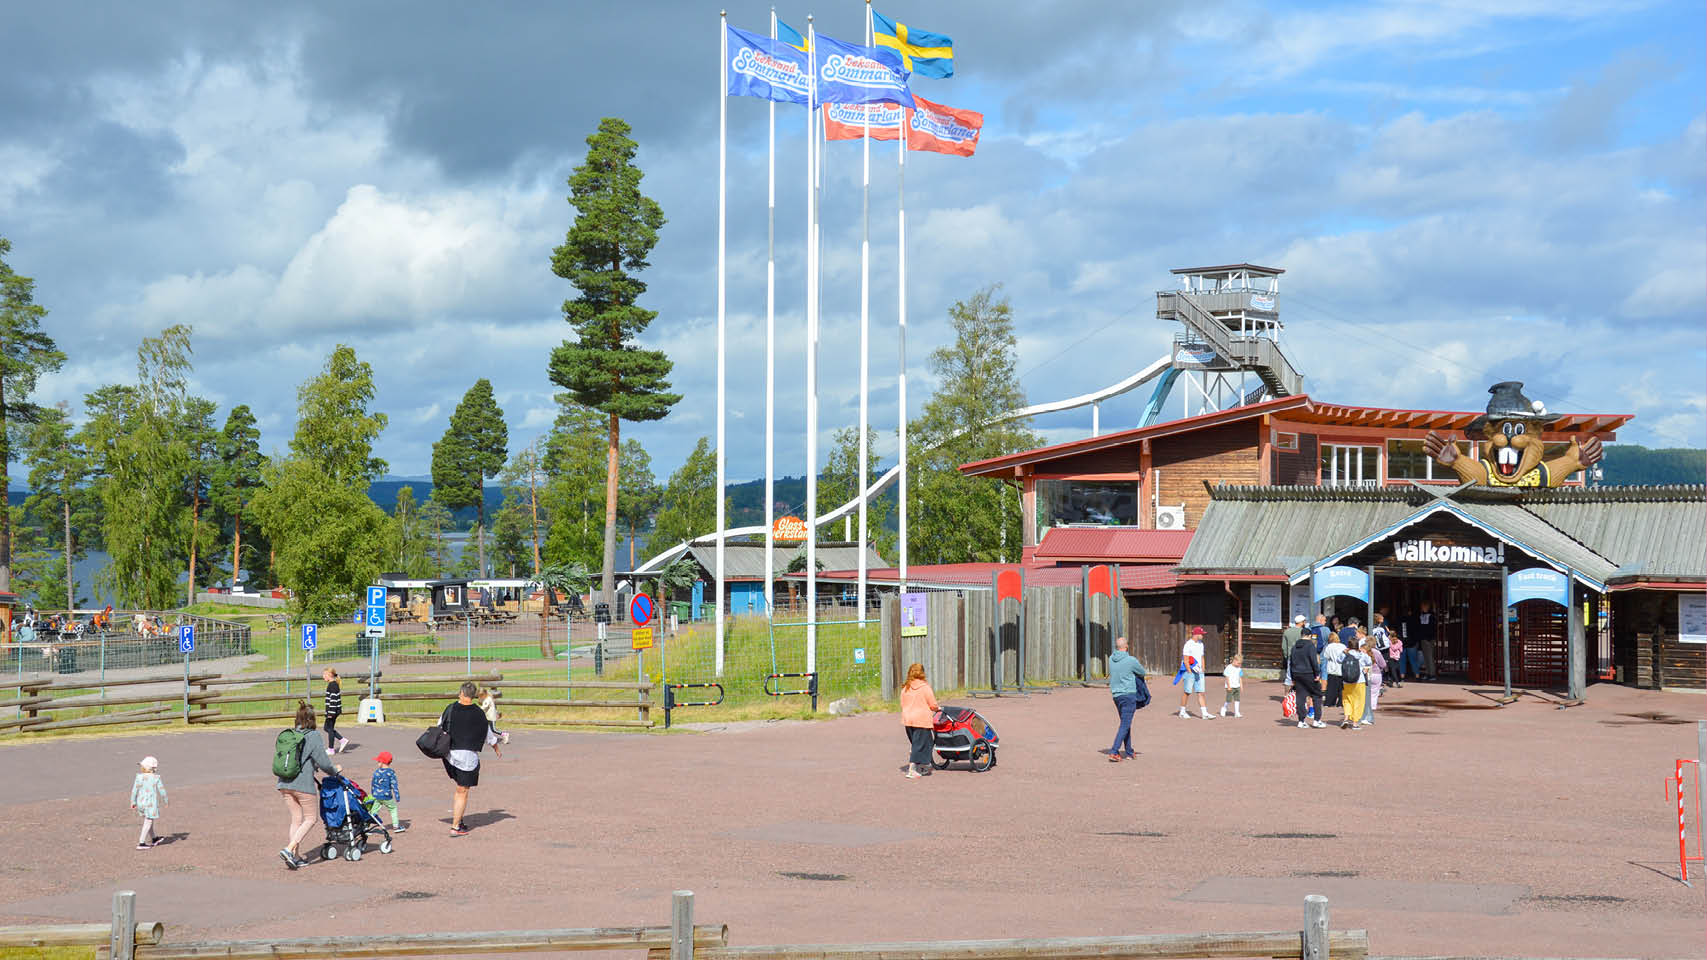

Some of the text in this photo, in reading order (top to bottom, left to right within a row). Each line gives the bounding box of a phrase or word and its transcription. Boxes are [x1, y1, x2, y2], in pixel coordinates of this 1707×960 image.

[735, 49, 809, 87] Sommarla
[754, 52, 797, 73] Leksand
[829, 103, 904, 122] Sommarlan
[778, 518, 803, 531] Glass
[1393, 539, 1505, 564] Välkomna!
[372, 588, 384, 605] P
[183, 627, 191, 637] P
[306, 626, 313, 635] P
